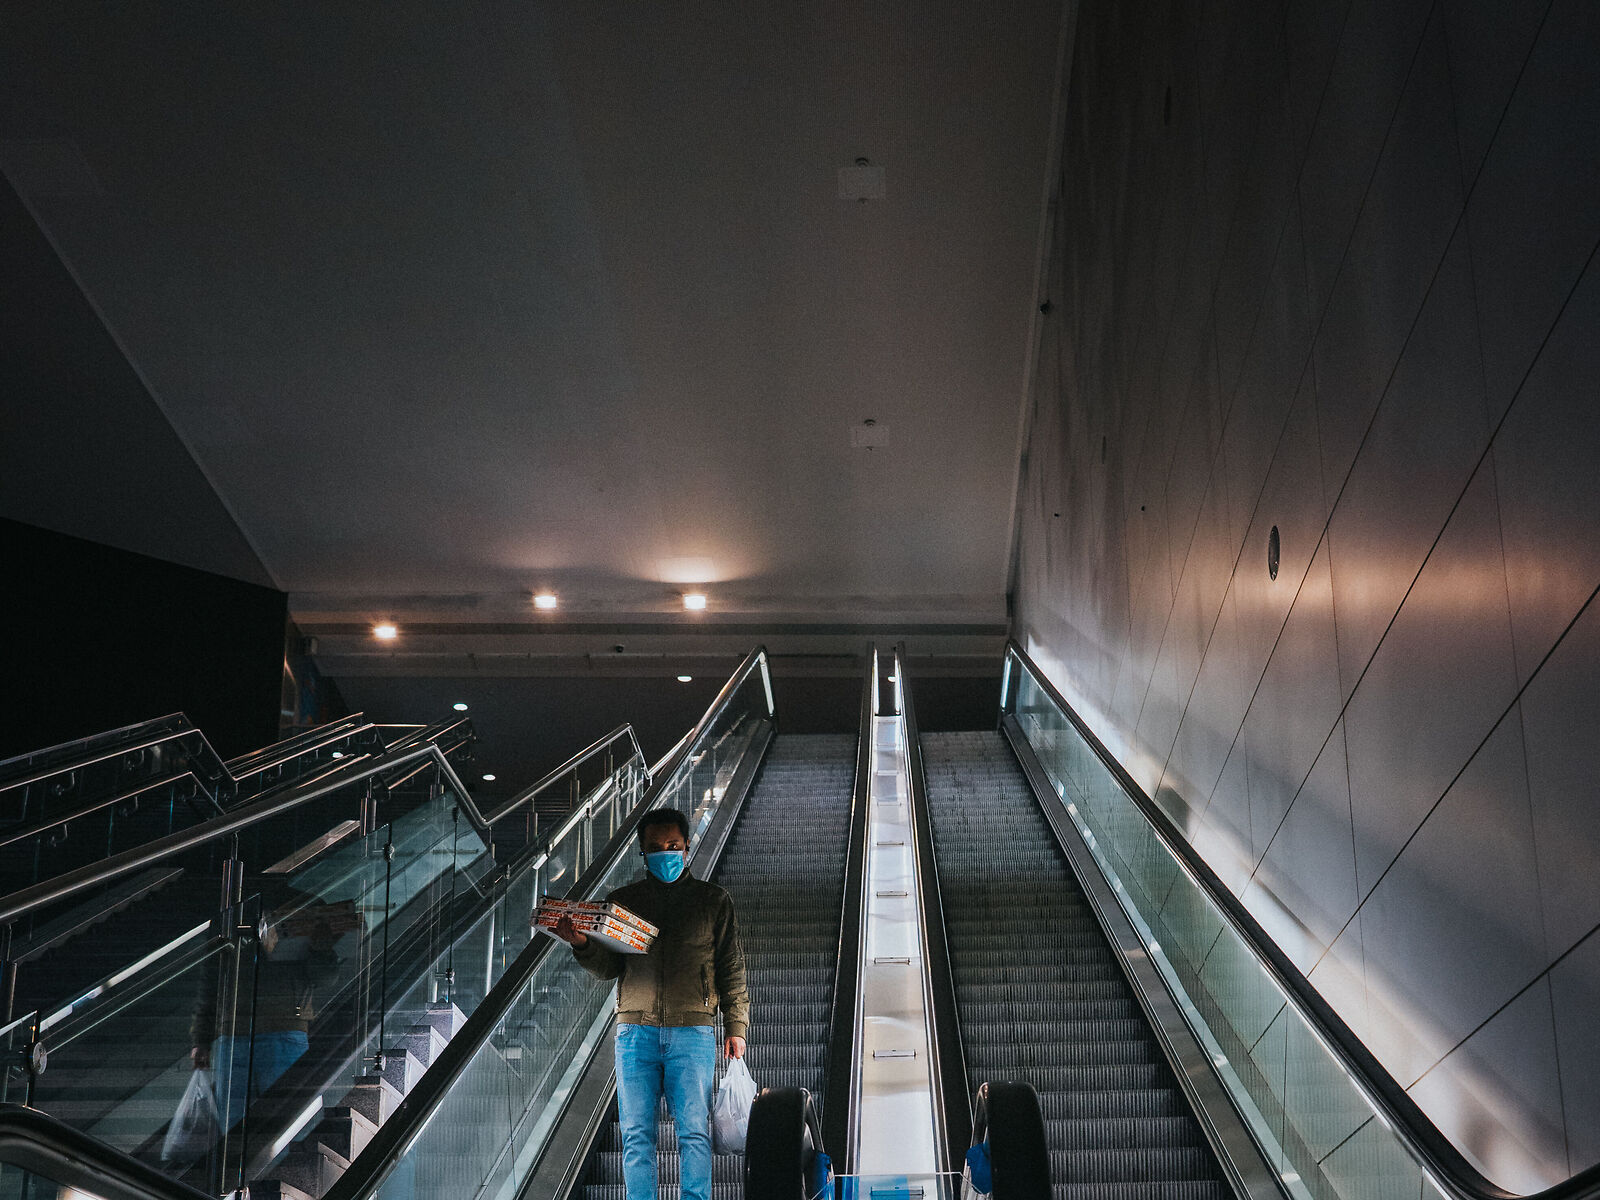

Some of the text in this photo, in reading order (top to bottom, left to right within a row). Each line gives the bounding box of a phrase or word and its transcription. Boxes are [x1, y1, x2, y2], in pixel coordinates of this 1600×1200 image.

[547, 900, 568, 908] Pizza
[609, 920, 646, 943] Pizza Pizza
[615, 909, 651, 933] Pizza Pizza
[606, 929, 644, 951] Pizza Pizza
